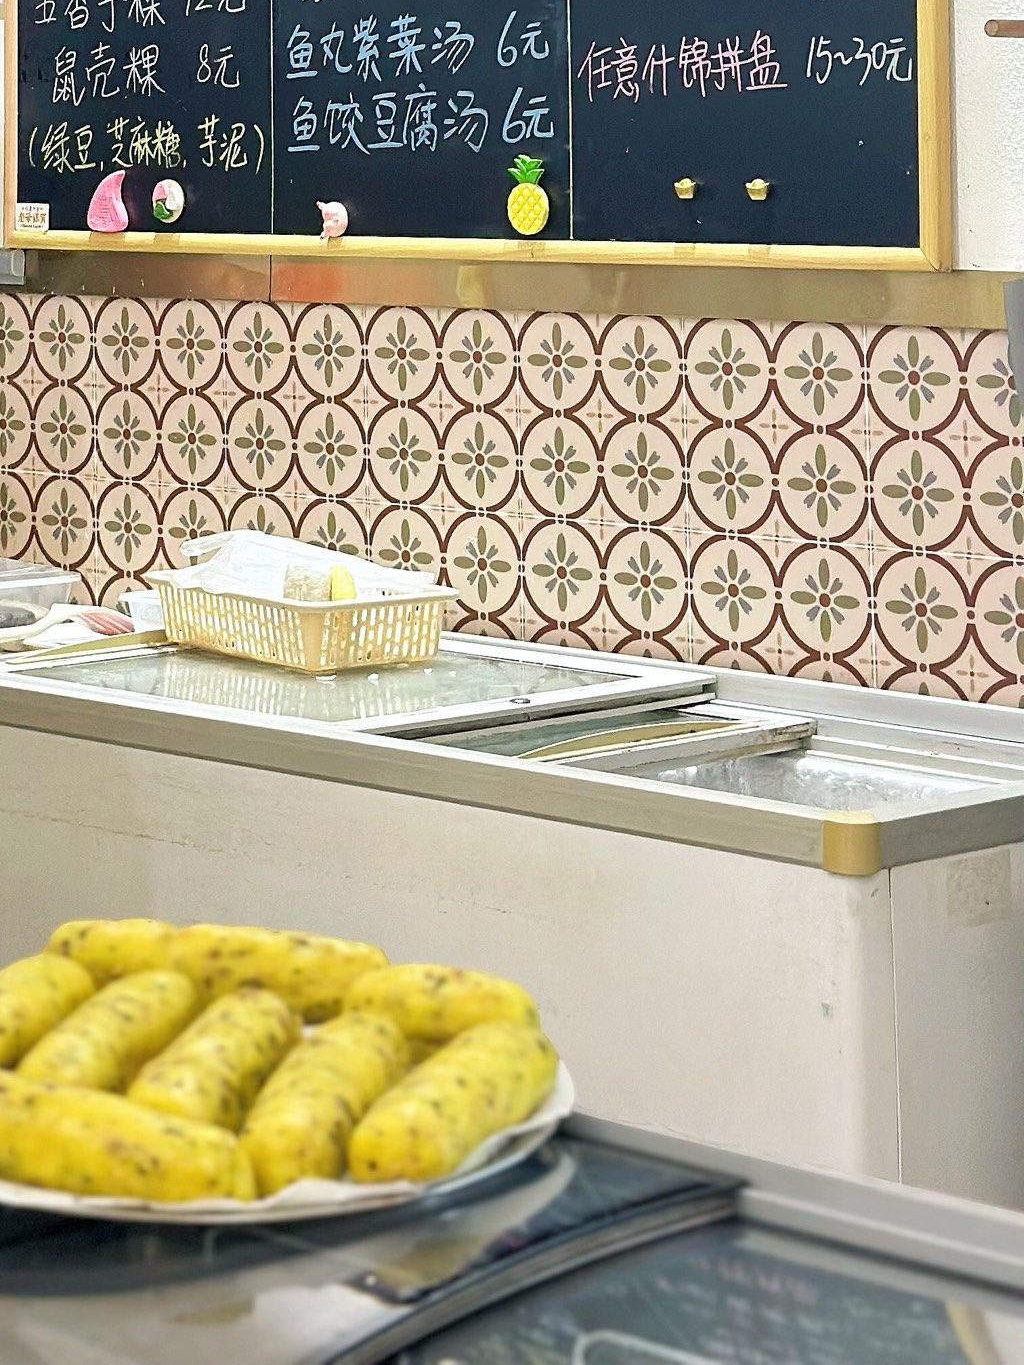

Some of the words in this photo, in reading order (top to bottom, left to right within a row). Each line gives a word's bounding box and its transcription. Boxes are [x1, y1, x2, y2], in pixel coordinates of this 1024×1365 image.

[52, 41, 166, 106] 鼠壳粿
[197, 45, 240, 88] 8元
[286, 12, 475, 83] 鱼丸紫菜汤
[496, 10, 550, 67] 6元
[578, 29, 787, 104] 任意什锦拼盘
[806, 35, 914, 87] 15~30元
[287, 82, 490, 155] 鱼饺豆腐汤
[501, 85, 556, 145] 6元
